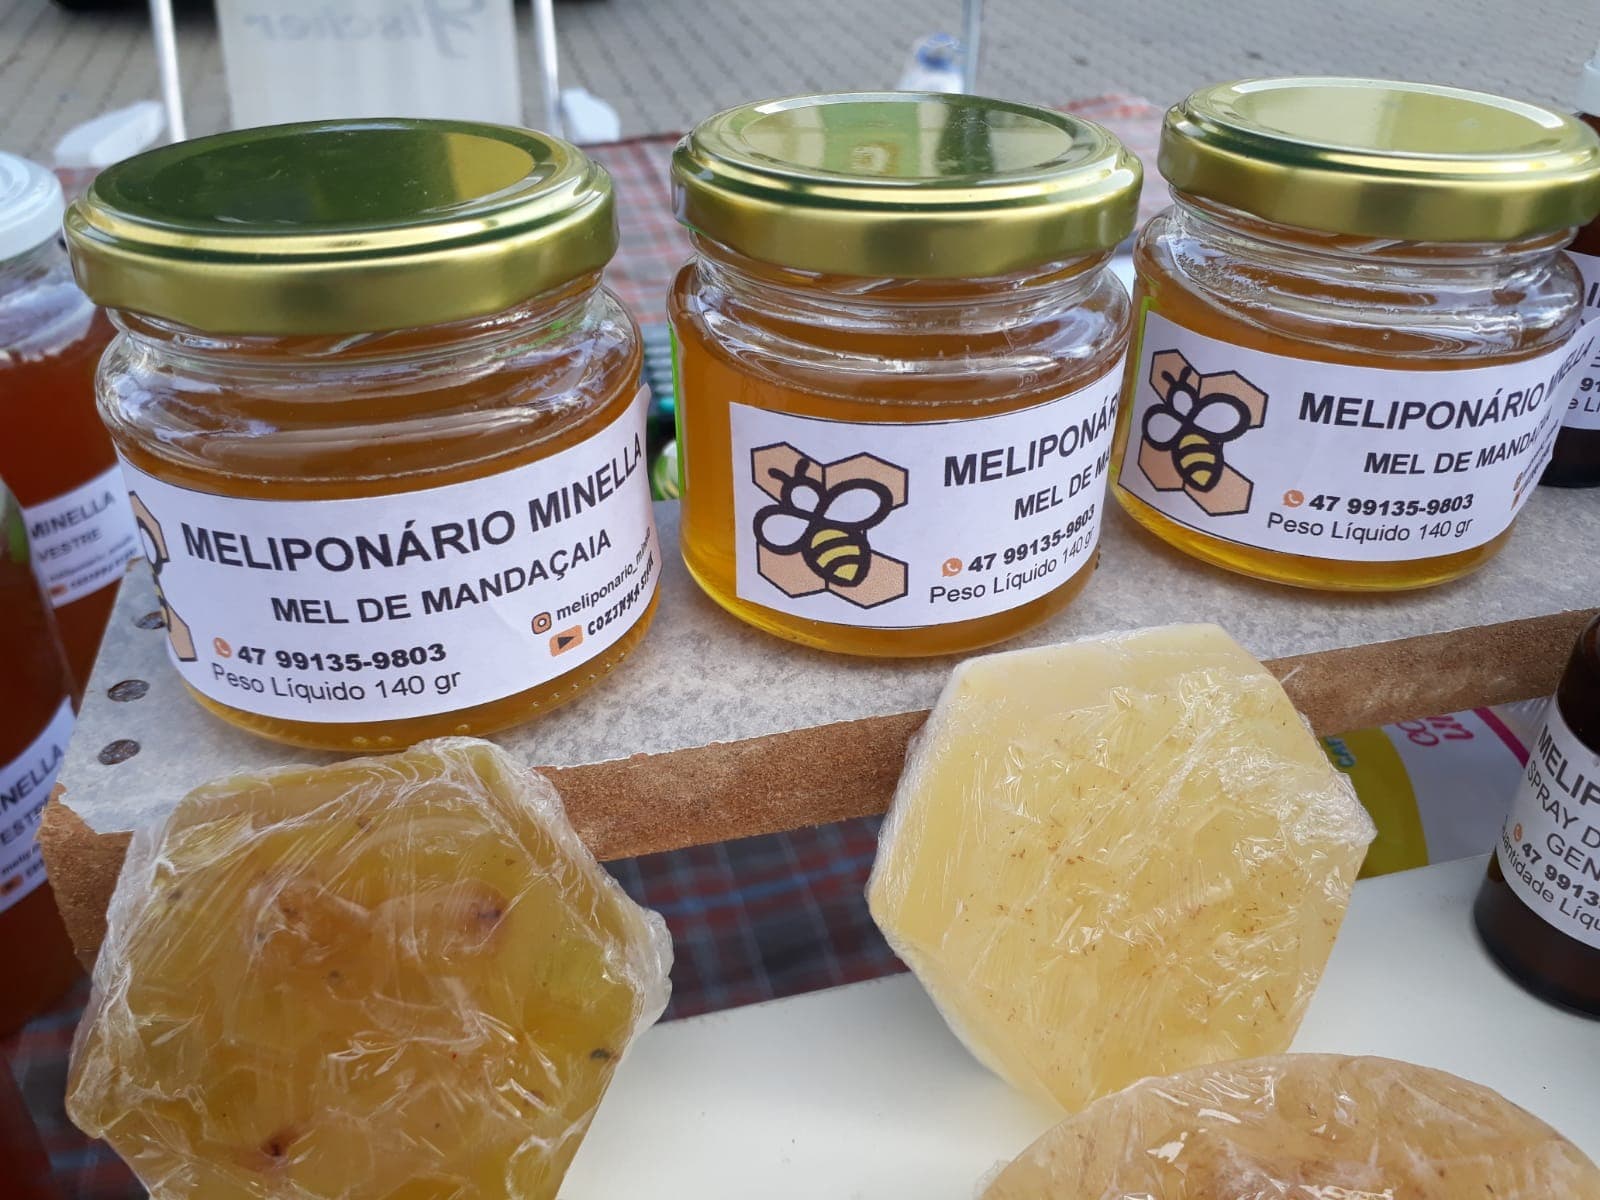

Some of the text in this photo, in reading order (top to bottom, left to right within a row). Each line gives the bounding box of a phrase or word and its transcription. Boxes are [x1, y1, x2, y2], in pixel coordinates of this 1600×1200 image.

[1298, 382, 1545, 430] MELIPONÁRIO
[1363, 452, 1426, 475] MEL
[1433, 451, 1473, 474] DE
[181, 510, 515, 573] MELIPONÁRIO
[528, 432, 642, 533] MINELLA
[1014, 485, 1063, 520] MEL
[1069, 464, 1093, 498] DE
[1309, 493, 1475, 517] 47 99135-9803
[968, 503, 1095, 573] 47 99135-9803
[1267, 512, 1475, 545] Peso Líquido 140 gr
[271, 528, 612, 625] MEL DE MANDAÇAIA
[930, 584, 986, 604] Peso
[993, 559, 1058, 594] Líquido
[1063, 536, 1083, 564] 140
[211, 662, 462, 704] Peso Líquido 140 gr
[237, 643, 447, 672] 47 99135-9803
[0, 744, 64, 816] NELLA
[1527, 760, 1579, 830] SPRAY
[1522, 842, 1543, 865] 47
